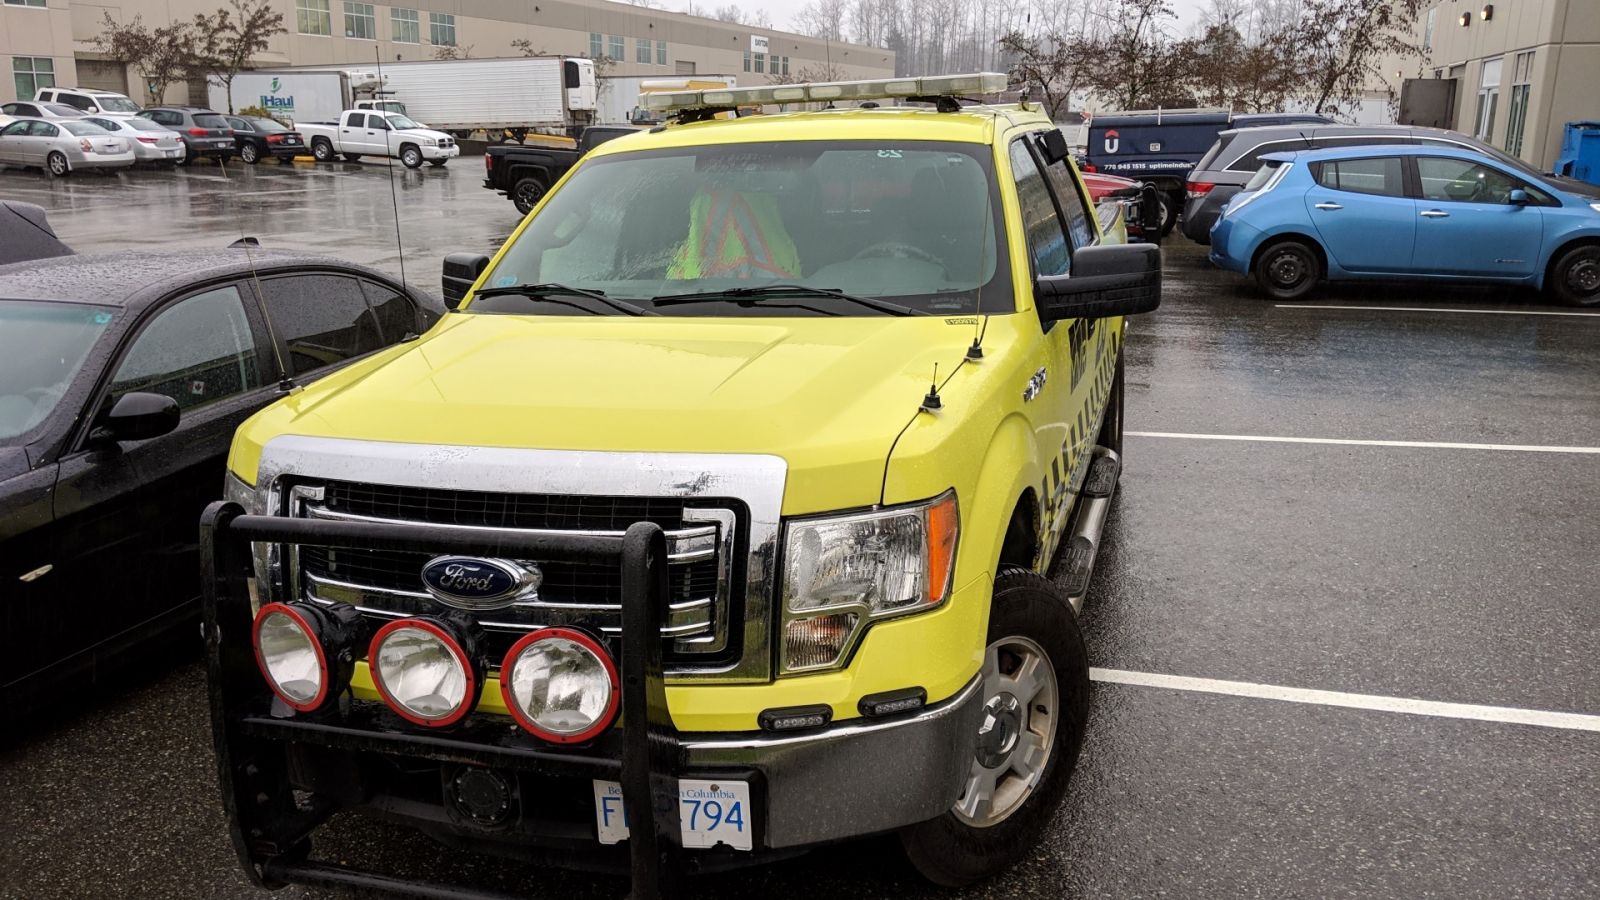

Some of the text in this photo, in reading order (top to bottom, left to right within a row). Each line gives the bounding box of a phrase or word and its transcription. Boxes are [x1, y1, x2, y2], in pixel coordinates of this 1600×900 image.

[440, 563, 494, 591] Ford
[686, 789, 735, 799] Columbia
[682, 799, 744, 832] 794
